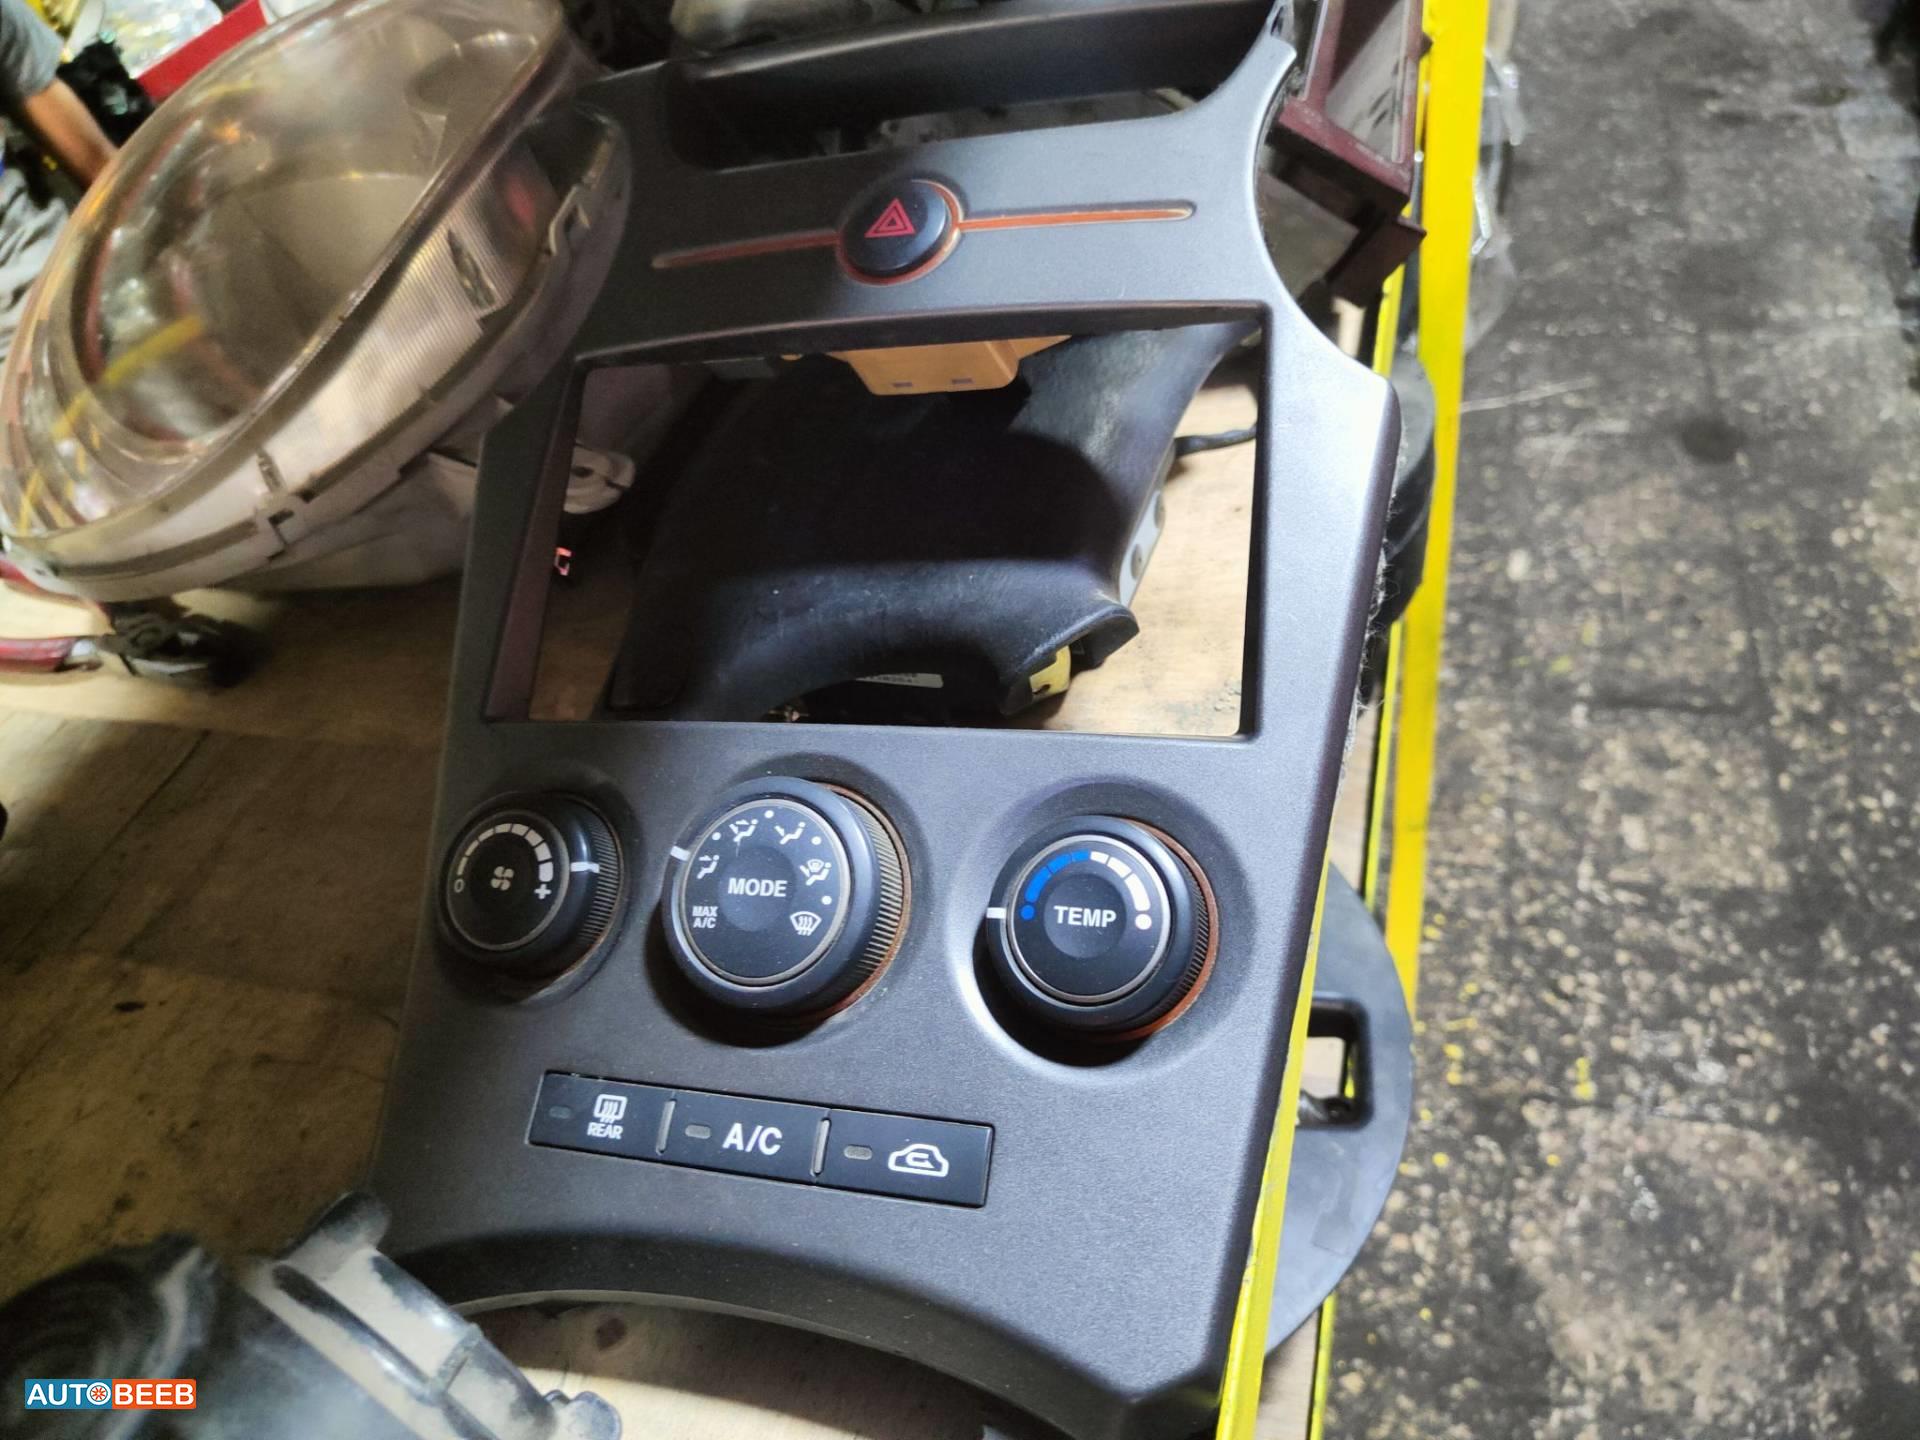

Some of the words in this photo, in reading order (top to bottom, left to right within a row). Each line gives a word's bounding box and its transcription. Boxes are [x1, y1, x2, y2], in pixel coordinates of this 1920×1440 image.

[727, 877, 788, 897] MODE
[692, 905, 719, 917] MAX
[1053, 905, 1117, 928] TEMP
[693, 917, 717, 929] A/C
[587, 1122, 624, 1140] REAR
[722, 1122, 783, 1156] A/C
